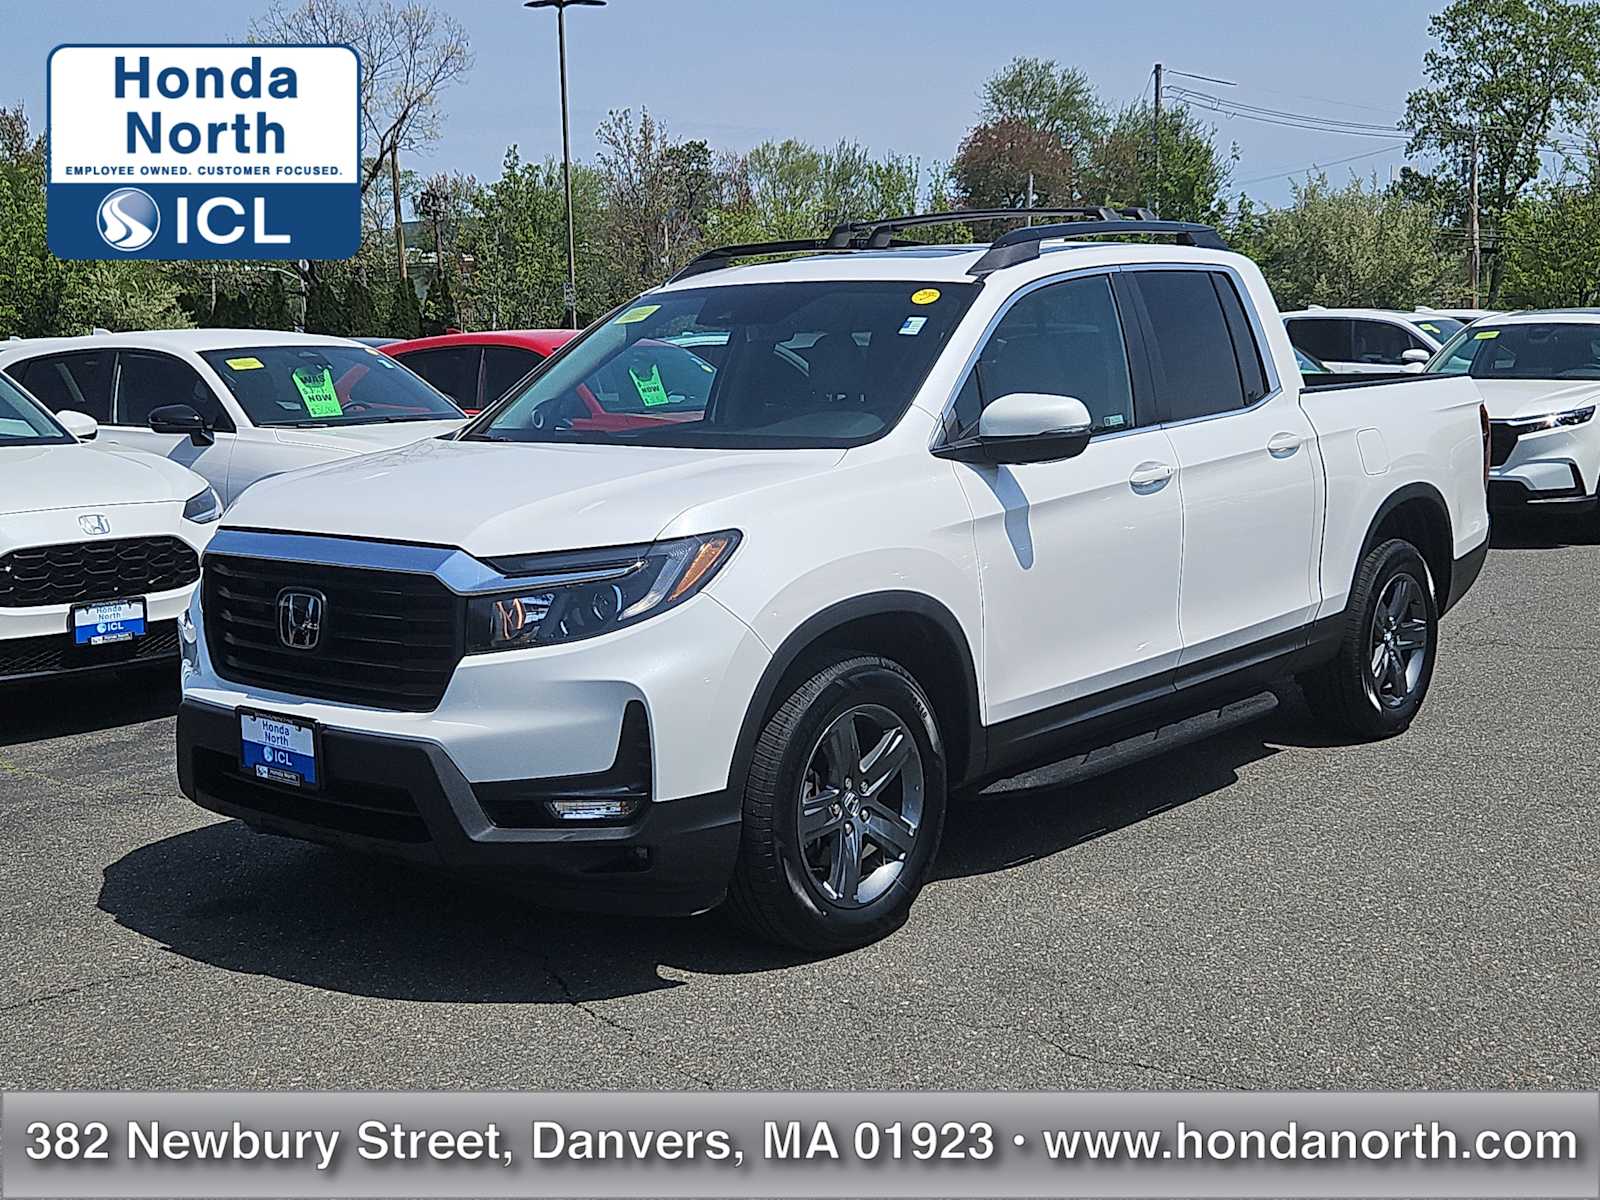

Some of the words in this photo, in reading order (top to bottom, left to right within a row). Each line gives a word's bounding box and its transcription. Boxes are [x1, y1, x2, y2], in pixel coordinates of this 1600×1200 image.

[307, 393, 332, 402] NOW
[107, 622, 124, 631] ICL
[262, 720, 290, 736] Honda
[264, 731, 289, 747] North
[274, 750, 293, 766] ICL
